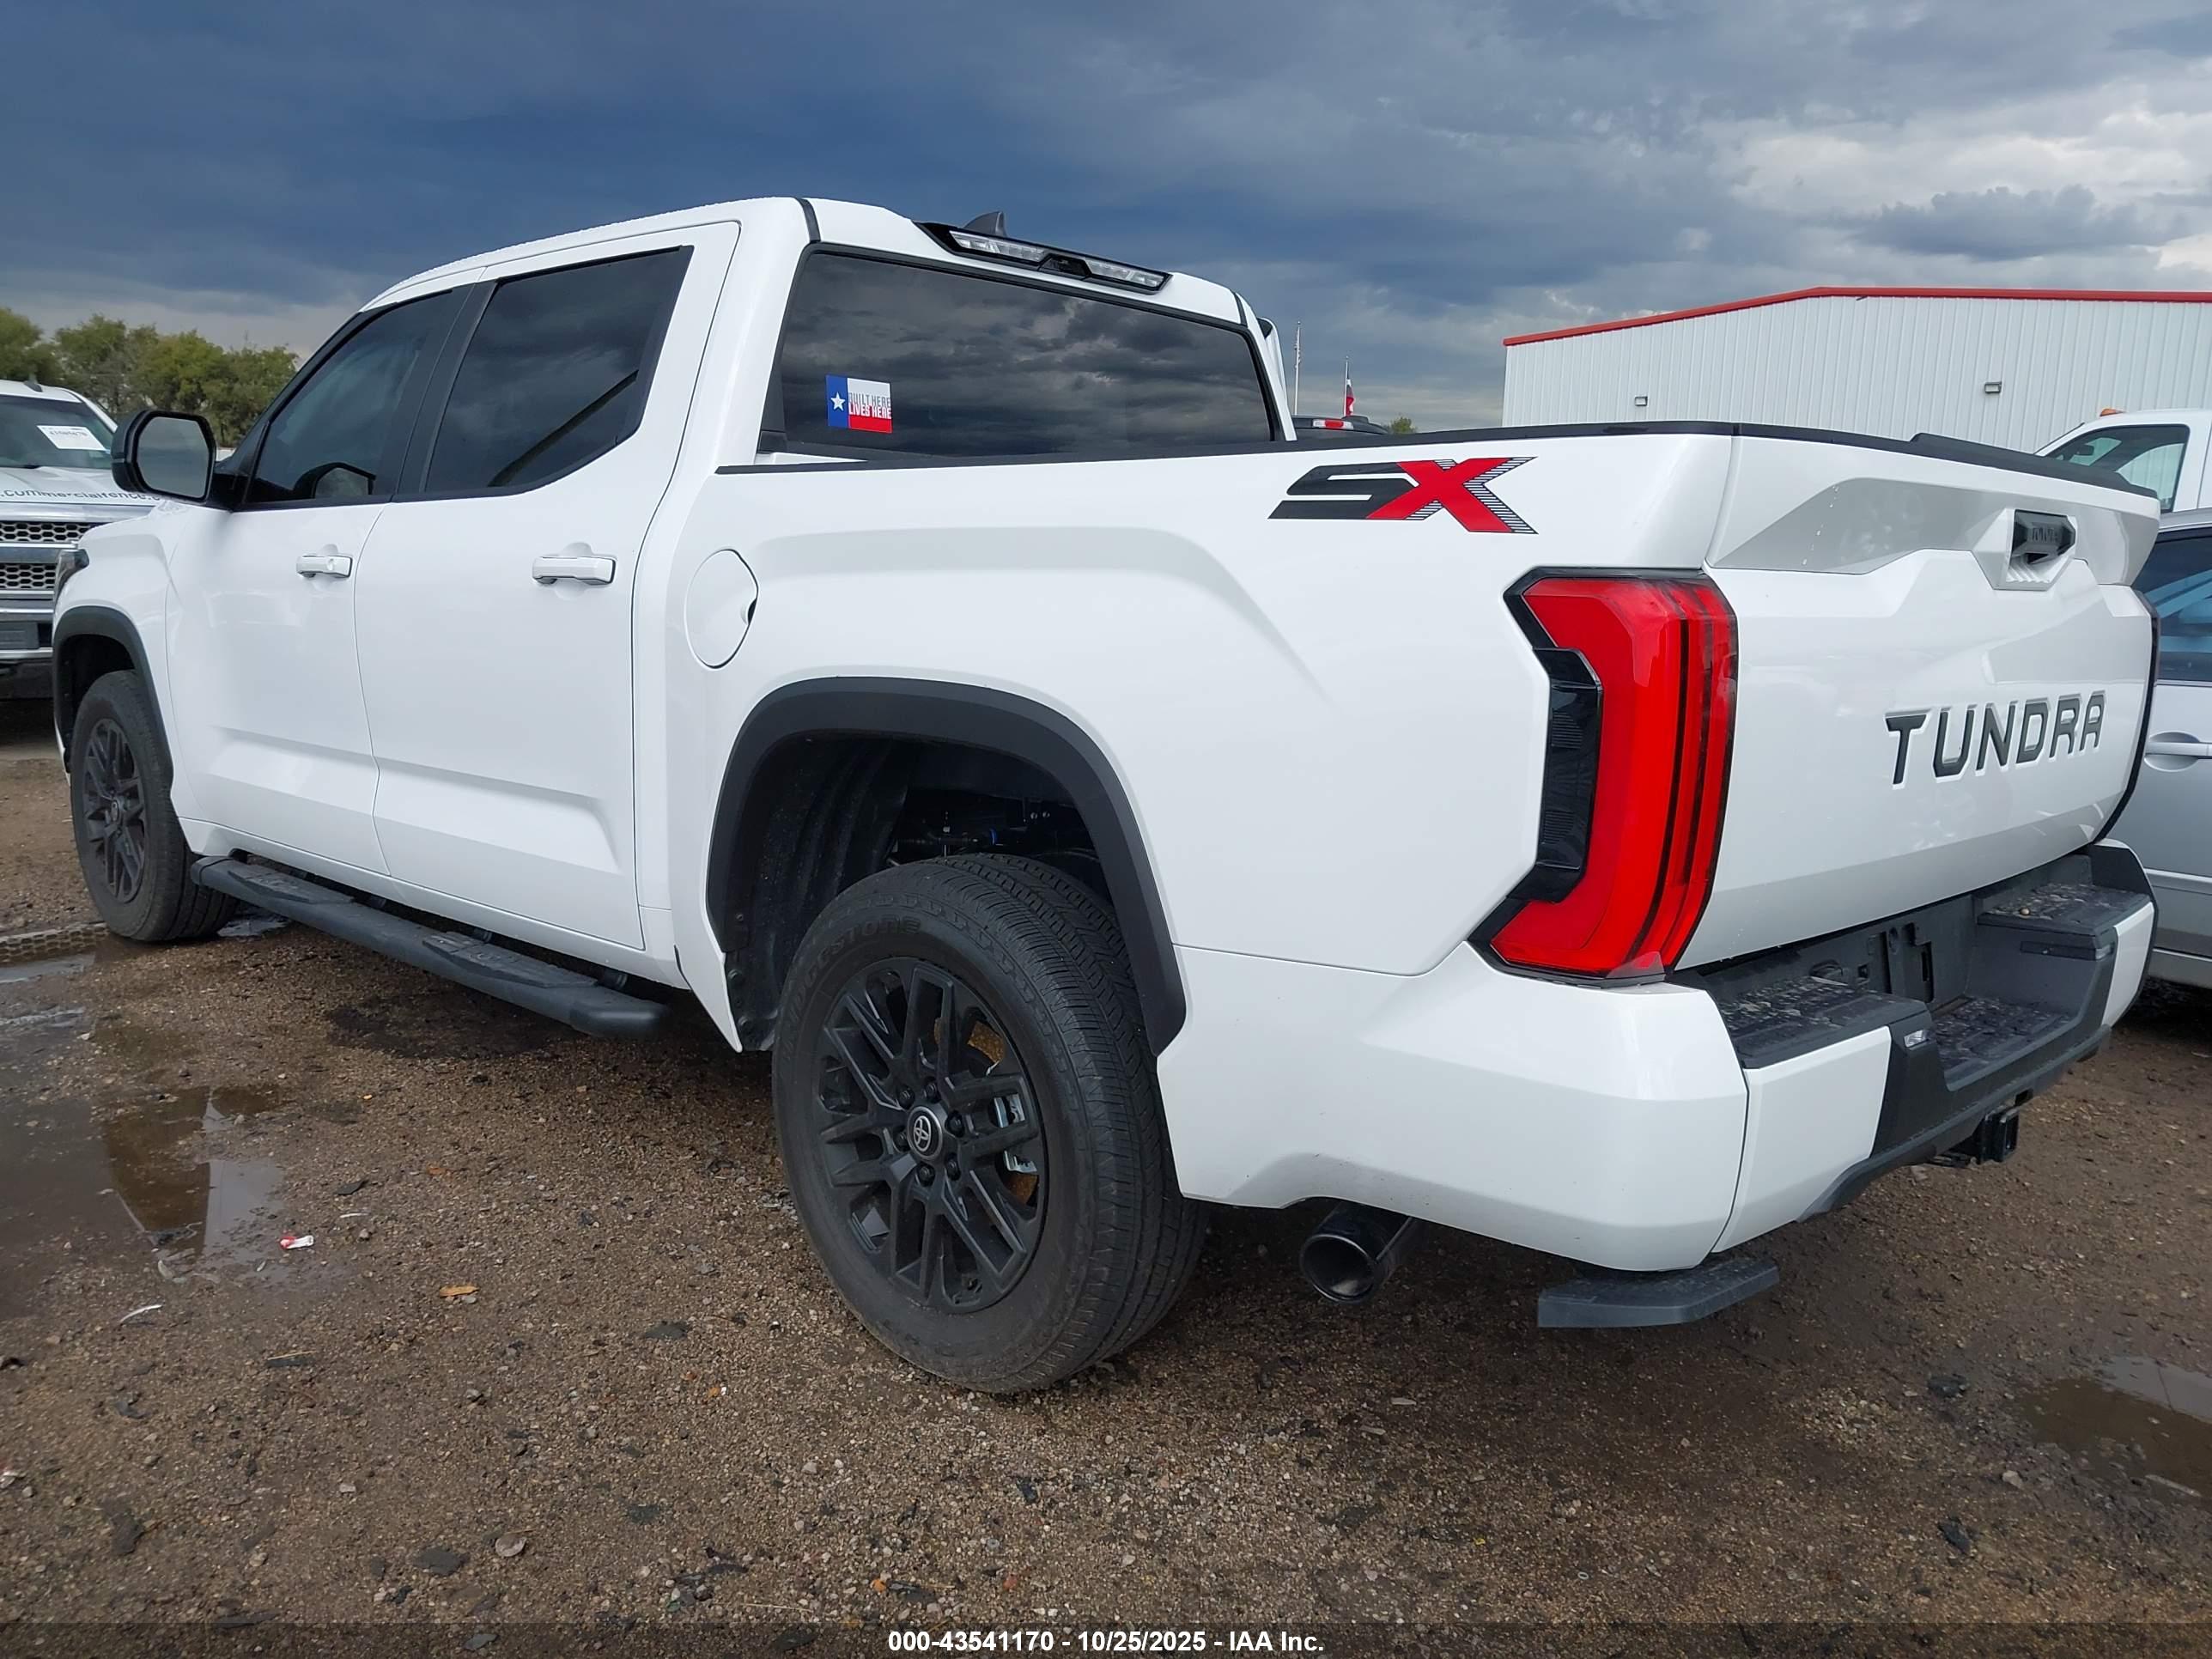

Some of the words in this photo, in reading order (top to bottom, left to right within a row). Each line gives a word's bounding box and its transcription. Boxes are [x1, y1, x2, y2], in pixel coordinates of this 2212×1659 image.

[848, 392, 871, 406] BUILT
[871, 395, 890, 409] HERE
[848, 403, 870, 417] LIVES
[871, 404, 891, 419] HERE
[1885, 691, 2106, 787] TUNDRA
